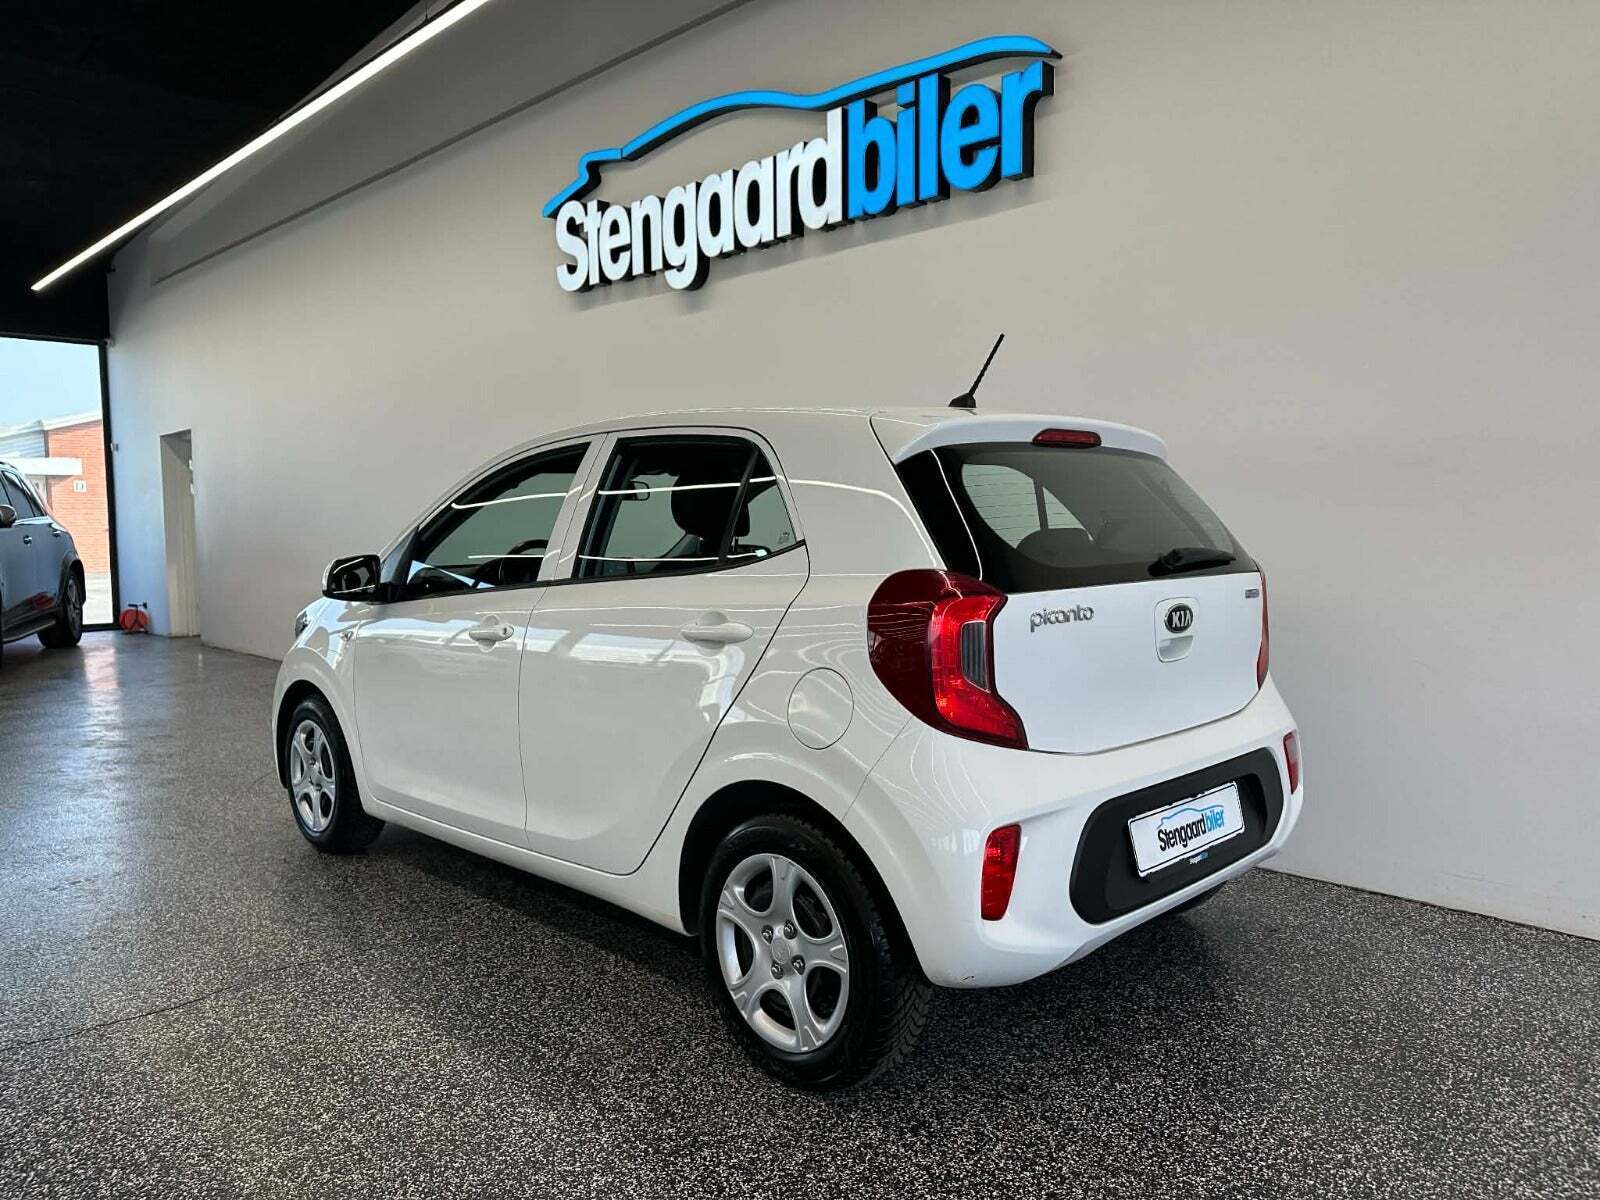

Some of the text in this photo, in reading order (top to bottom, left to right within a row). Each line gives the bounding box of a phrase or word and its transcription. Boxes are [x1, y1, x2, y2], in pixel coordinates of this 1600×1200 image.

[555, 60, 1053, 291] Stengaardbiler
[1029, 604, 1095, 632] picanto
[1171, 610, 1192, 628] KIA
[1157, 809, 1225, 851] Stengaardbiler
